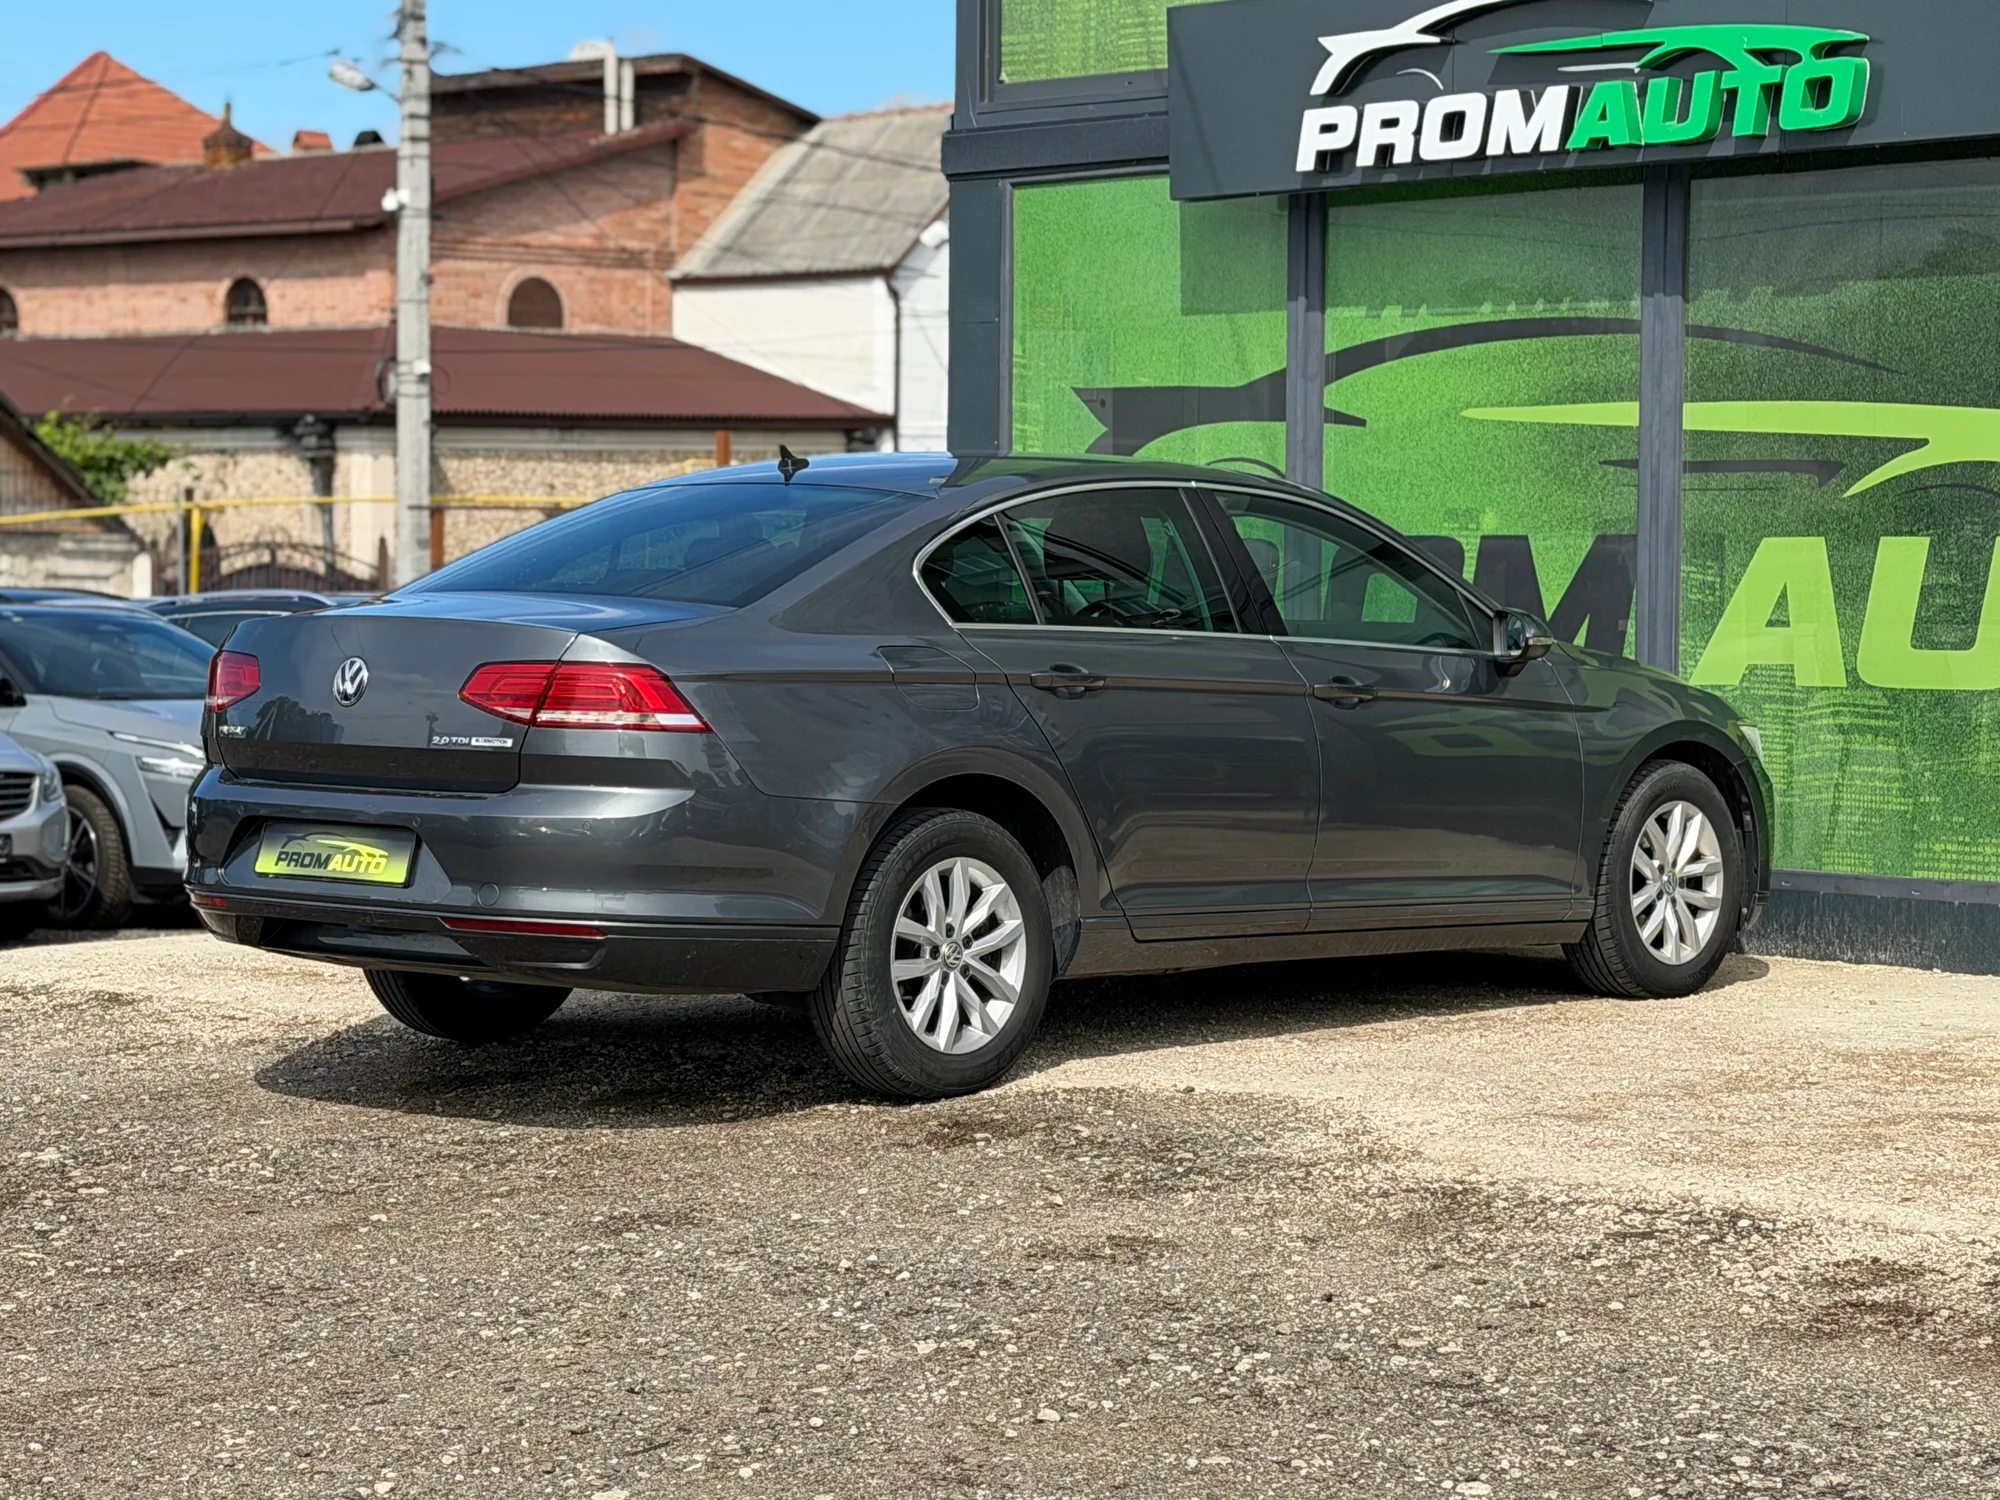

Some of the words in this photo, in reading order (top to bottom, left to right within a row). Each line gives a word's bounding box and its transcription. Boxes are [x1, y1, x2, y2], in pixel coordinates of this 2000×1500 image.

[1296, 57, 1870, 172] PROMAUTO
[450, 737, 470, 745] TDI
[275, 851, 388, 874] PROMAUTO
